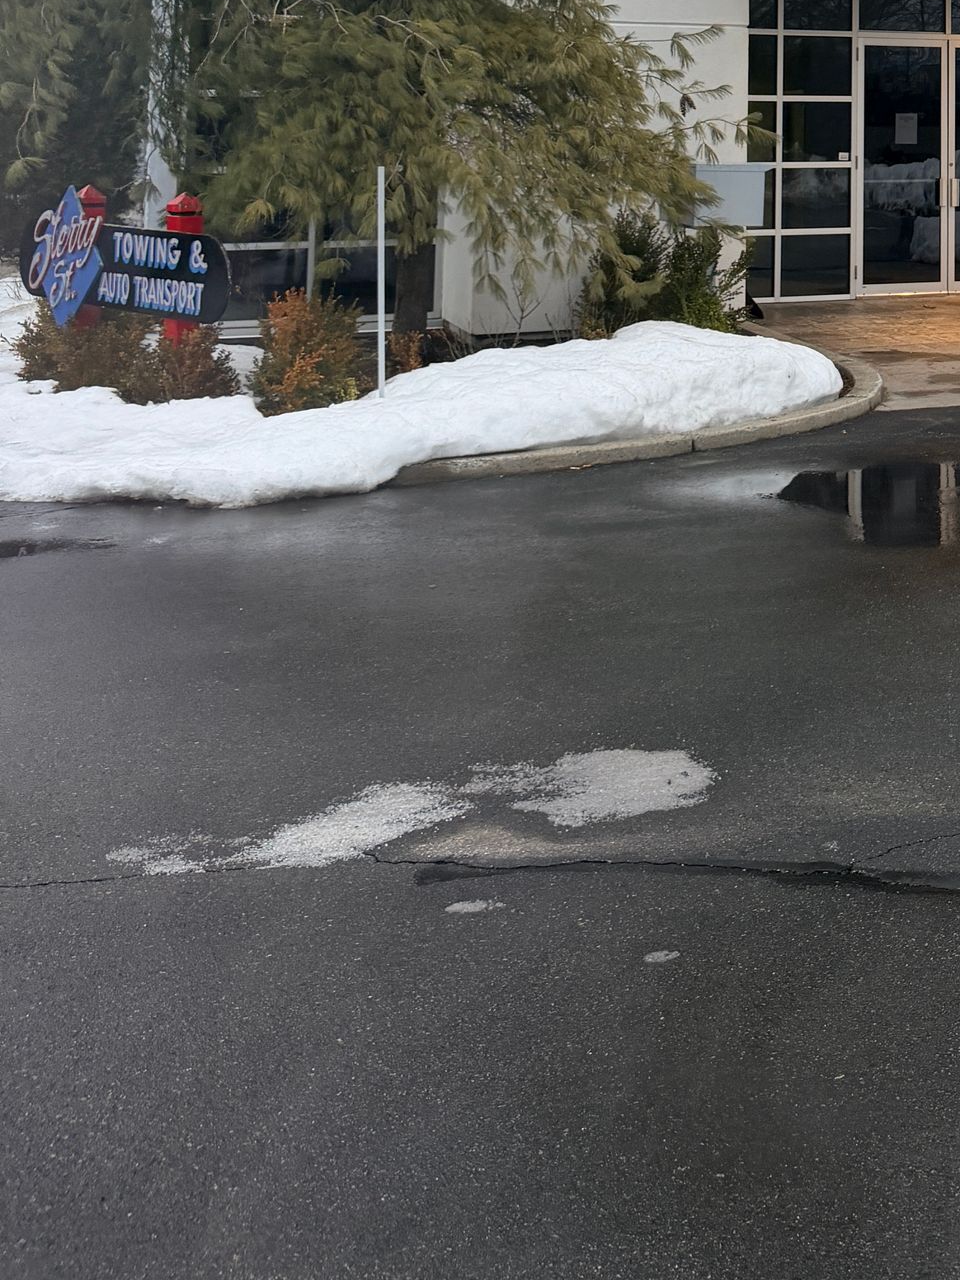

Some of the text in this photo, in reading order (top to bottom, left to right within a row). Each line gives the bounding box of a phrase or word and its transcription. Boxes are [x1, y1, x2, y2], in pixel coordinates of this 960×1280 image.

[113, 231, 208, 275] TOWING &
[98, 271, 205, 317] AUTO TRANSPORT
